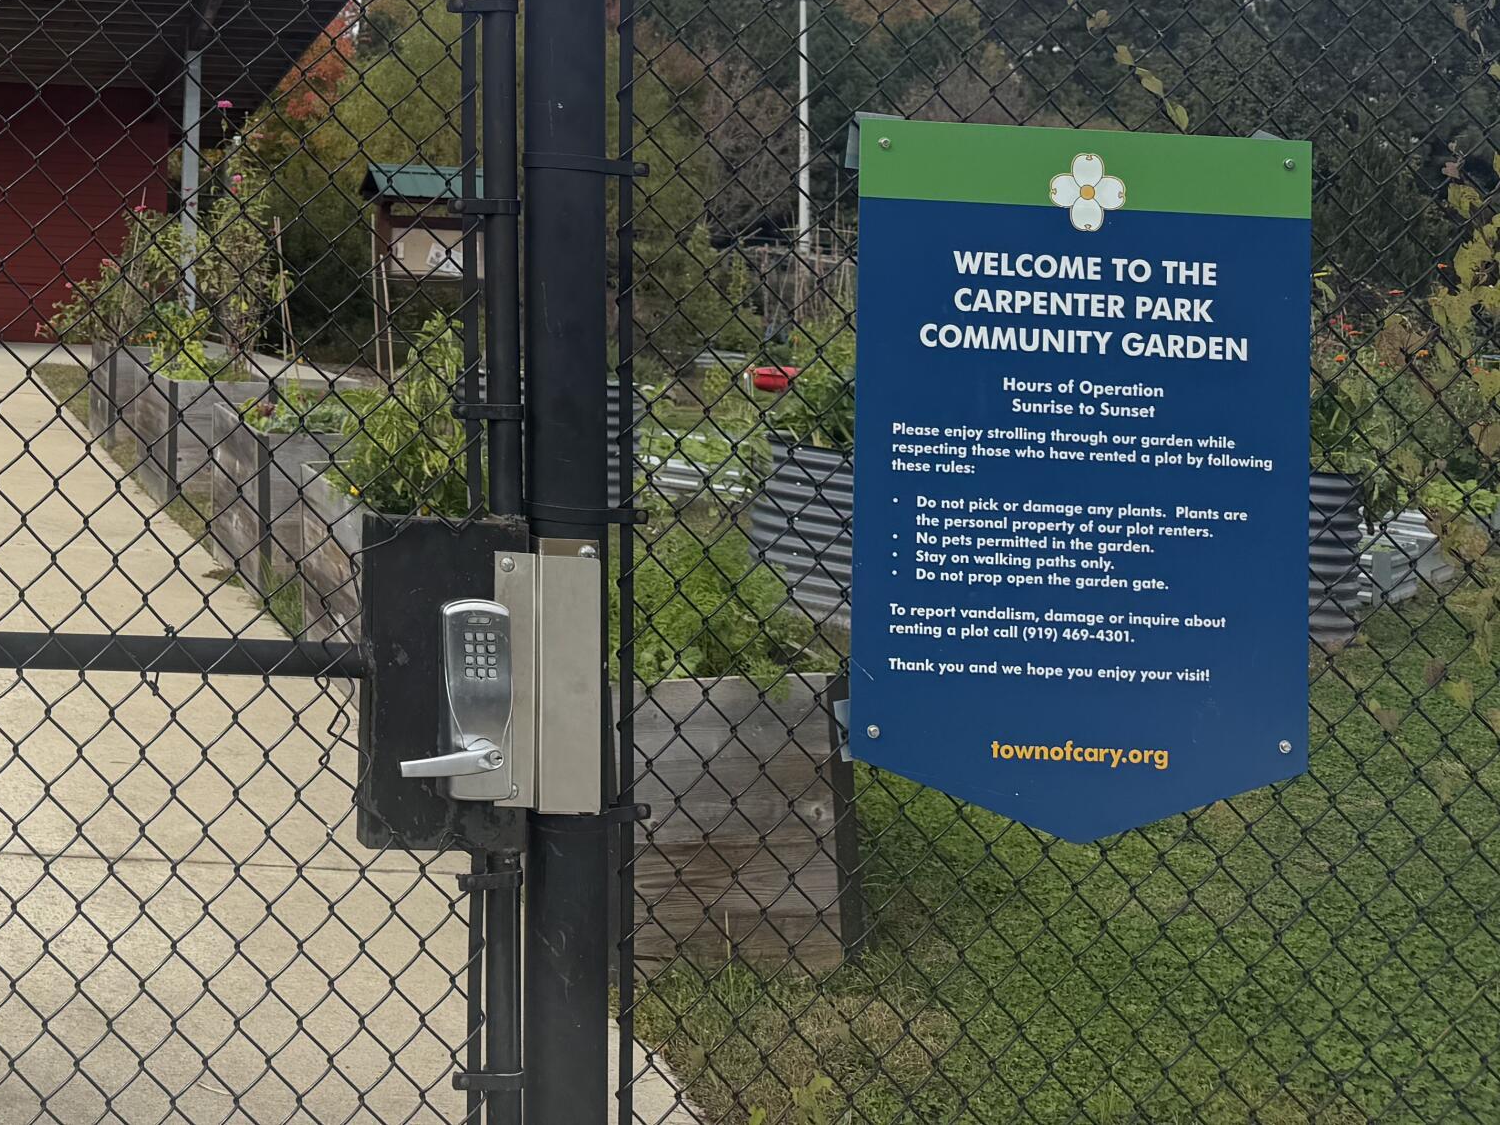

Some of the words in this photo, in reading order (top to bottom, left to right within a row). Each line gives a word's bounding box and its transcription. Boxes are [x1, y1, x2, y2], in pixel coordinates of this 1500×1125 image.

[952, 250, 1102, 281] WELCOME
[1111, 257, 1152, 283] TO
[1161, 260, 1217, 286] THE
[954, 287, 1126, 319] CARPENTER
[1135, 295, 1214, 323] PARK
[919, 323, 1113, 355] COMMUNITY
[1121, 332, 1248, 362] GARDEN
[1003, 376, 1053, 393] Hours
[1057, 378, 1075, 394] of
[1078, 380, 1164, 399] Operation
[1011, 398, 1074, 415] Sunrise
[1078, 402, 1095, 416] to
[1099, 401, 1156, 418] Sunset
[892, 422, 940, 437] Please
[944, 425, 984, 442] enjoy
[987, 426, 1046, 444] strolling
[1050, 428, 1108, 447] through
[1112, 435, 1137, 445] our
[1140, 433, 1193, 449] garden
[1196, 435, 1236, 450] while
[891, 457, 931, 472] these
[935, 460, 976, 474] rules:
[892, 442, 967, 459] respecting
[971, 443, 1011, 458] those
[1014, 445, 1046, 459] who
[1049, 446, 1085, 461] have
[1089, 449, 1137, 463] rented
[1140, 454, 1150, 464] a
[1154, 451, 1183, 467] plot
[1186, 452, 1204, 469] by
[1207, 453, 1273, 472] following
[916, 495, 937, 509] Do
[941, 498, 965, 510] not
[968, 497, 999, 513] pick
[1002, 502, 1020, 512] or
[1022, 499, 1083, 517] damage
[1087, 505, 1114, 519] any
[1117, 503, 1167, 519] plants.
[1175, 505, 1220, 520] Plants
[1223, 511, 1248, 521] are
[915, 513, 940, 527] the
[943, 516, 1008, 530] personal
[1012, 520, 1076, 535] property
[1079, 519, 1094, 533] of
[1097, 523, 1123, 534] our
[1126, 521, 1155, 538] plot
[1158, 525, 1214, 538] renters.
[916, 531, 938, 545] No
[941, 534, 973, 548] pets
[976, 535, 1048, 550] permitted
[1051, 536, 1066, 550] in
[1069, 537, 1094, 551] the
[1097, 539, 1155, 555] garden.
[915, 549, 947, 566] Stay
[950, 554, 970, 564] on
[973, 552, 1032, 570] walking
[1035, 554, 1077, 570] paths
[1080, 556, 1115, 573] only.
[915, 567, 936, 581] Do
[940, 570, 964, 582] not
[968, 573, 1003, 587] prop
[1006, 574, 1044, 587] open
[1047, 572, 1071, 586] the
[1075, 574, 1128, 590] garden
[1132, 578, 1169, 592] gate.
[889, 602, 906, 616] To
[910, 606, 957, 620] report
[959, 606, 1040, 623] vandalism,
[1044, 608, 1105, 627] damage
[1108, 614, 1125, 624] or
[1128, 611, 1180, 629] inquire
[1184, 614, 1227, 628] about
[889, 622, 942, 639] renting
[946, 626, 957, 636] a
[960, 623, 990, 640] plot
[993, 625, 1018, 639] call
[1022, 626, 1058, 643] (919)
[1061, 627, 1135, 643] 469-4301.
[888, 657, 935, 672] Thank
[938, 662, 965, 676] you
[968, 660, 998, 674] and
[1001, 665, 1023, 675] we
[1026, 662, 1064, 679] hope
[1067, 667, 1093, 680] you
[1097, 665, 1137, 683] enjoy
[1139, 670, 1173, 683] your
[1175, 668, 1210, 682] visit!
[990, 739, 1169, 770] townofcary.org
